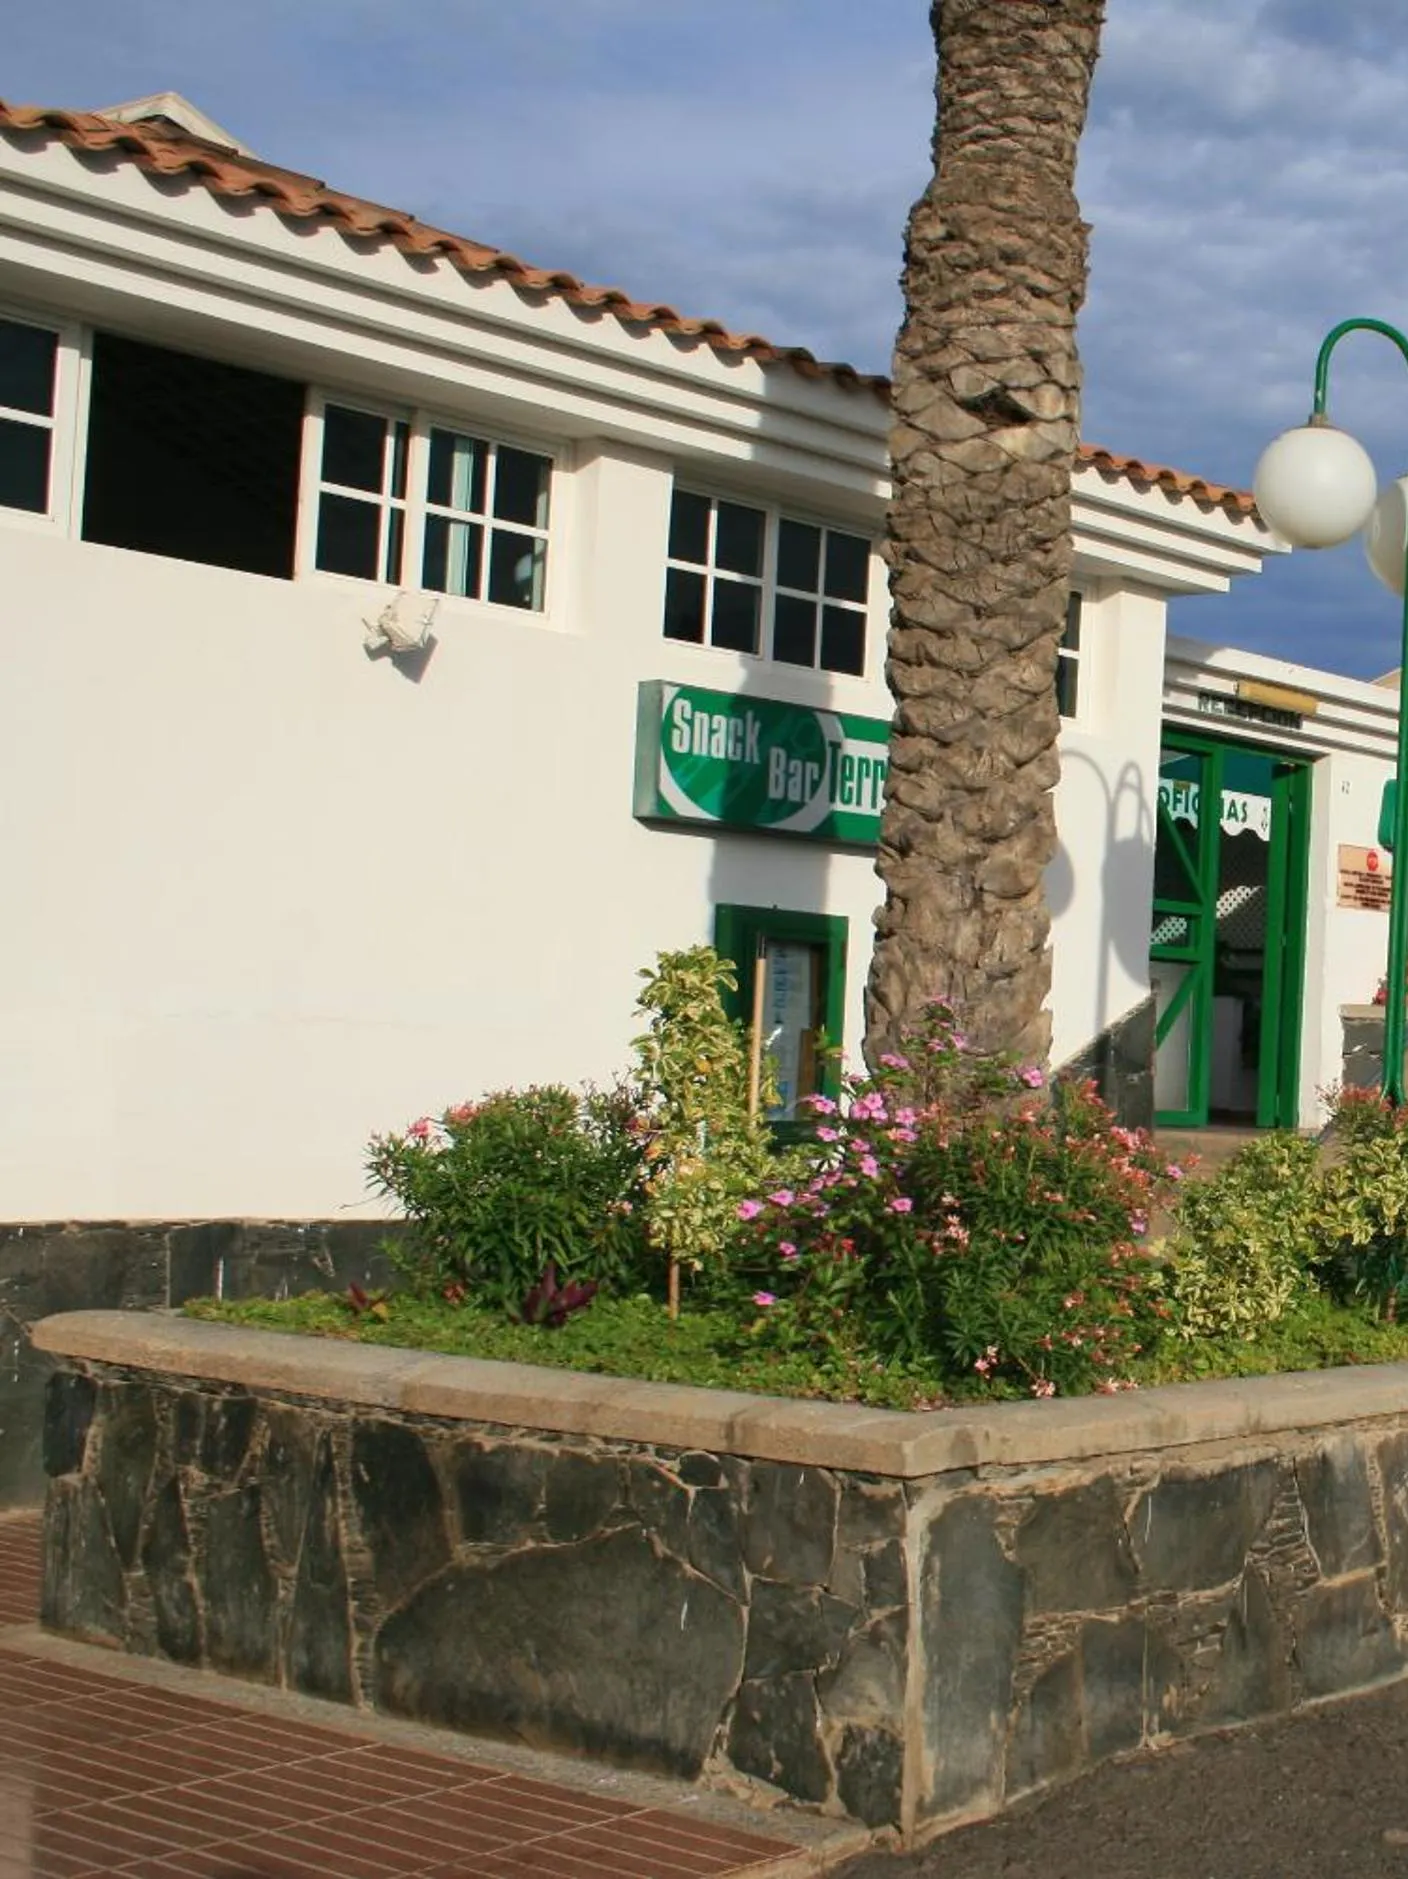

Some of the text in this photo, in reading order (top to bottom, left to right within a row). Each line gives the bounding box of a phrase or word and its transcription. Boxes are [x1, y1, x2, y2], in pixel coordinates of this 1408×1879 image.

[671, 699, 888, 809] Snack Bar Terr
[1158, 786, 1248, 824] OFICAS
